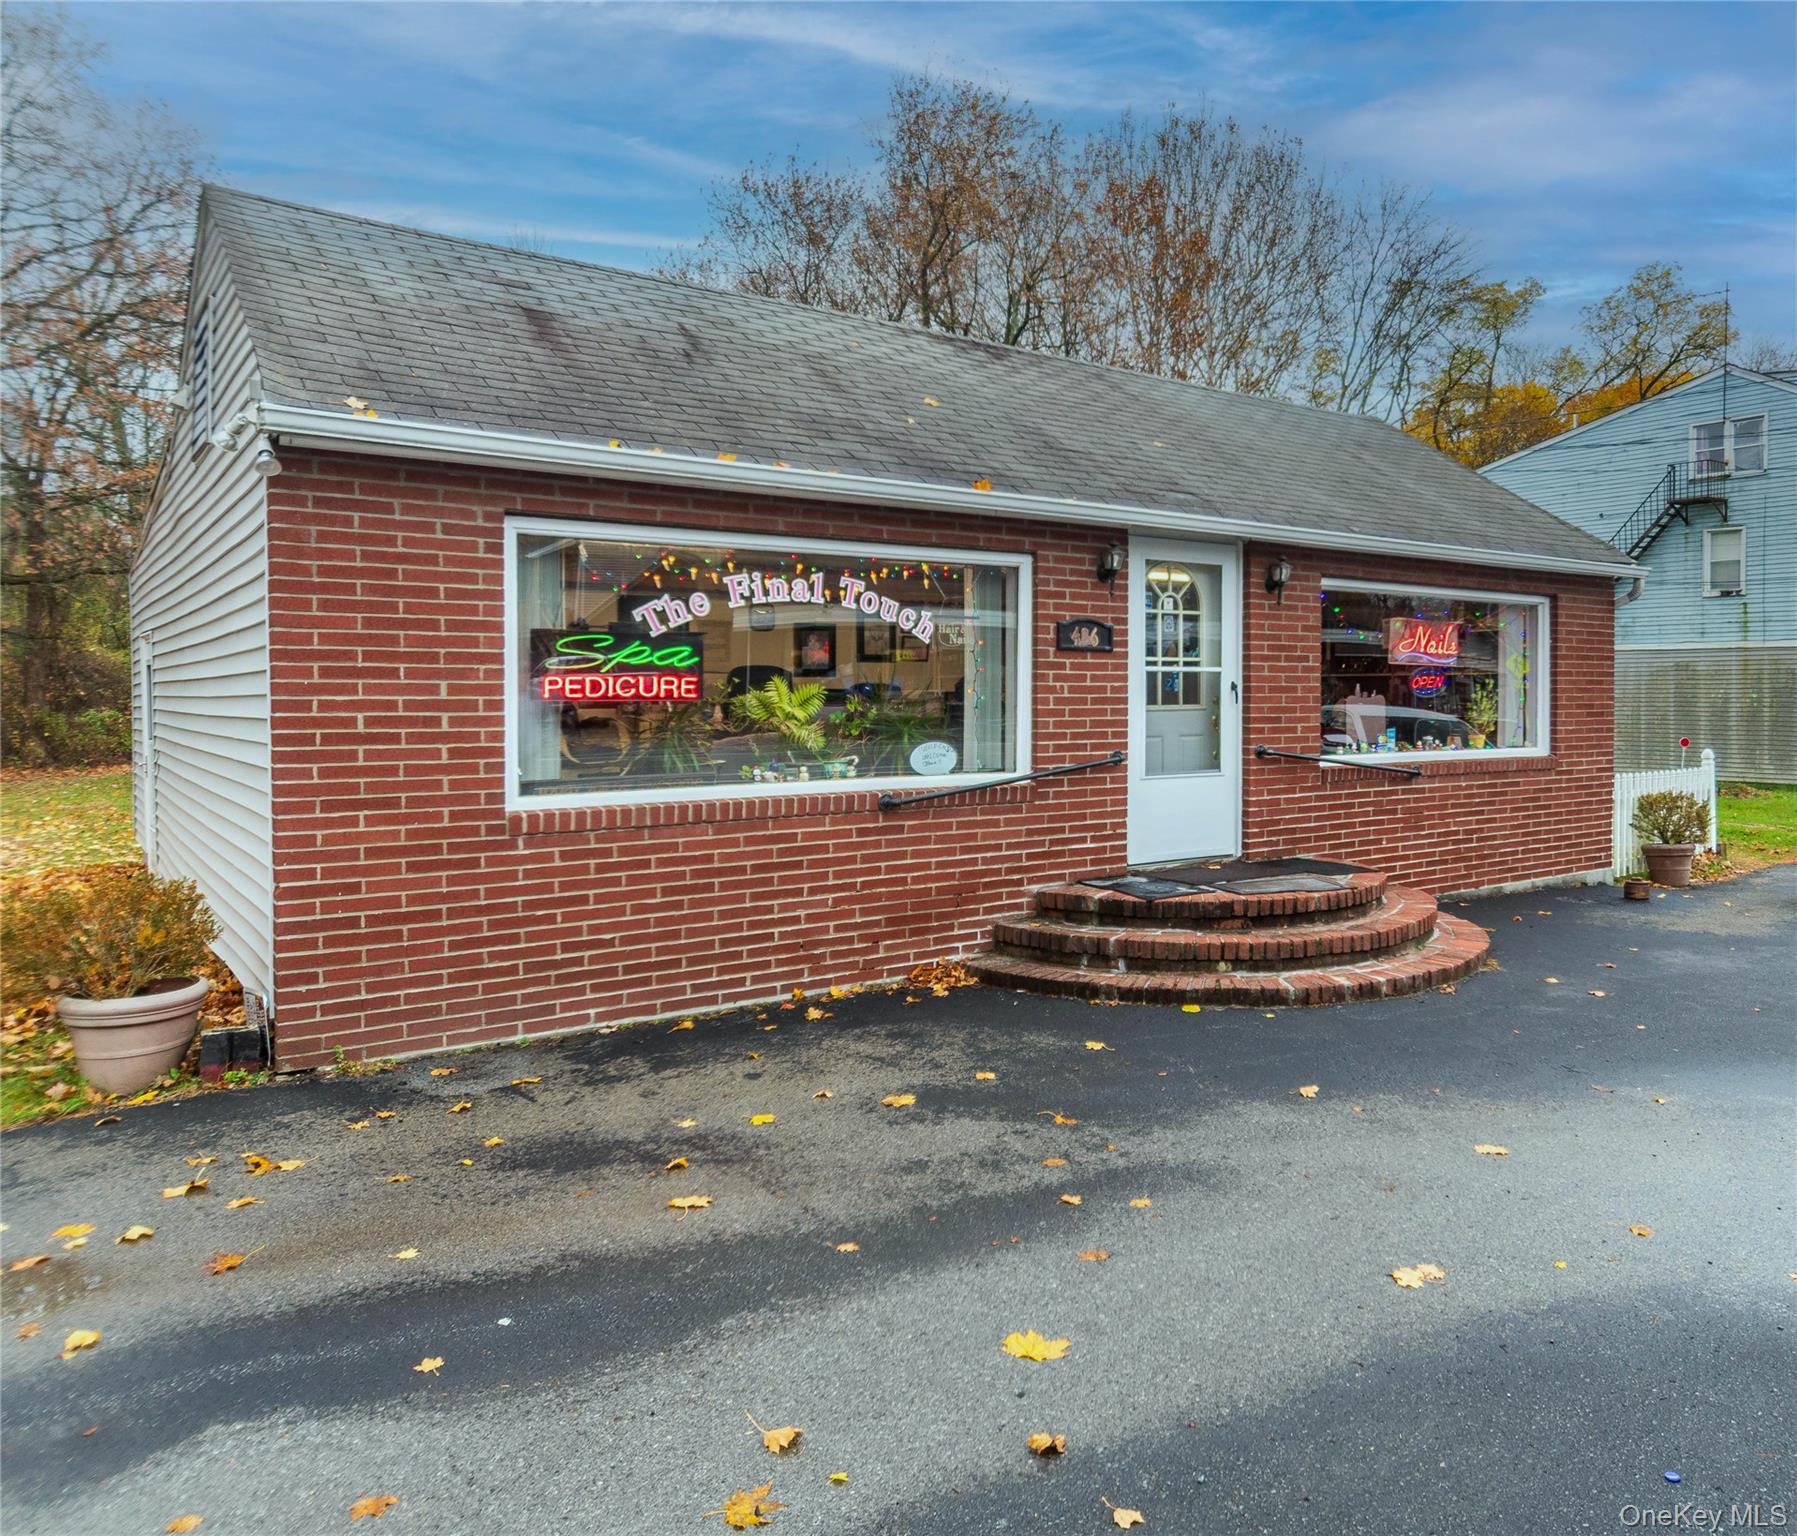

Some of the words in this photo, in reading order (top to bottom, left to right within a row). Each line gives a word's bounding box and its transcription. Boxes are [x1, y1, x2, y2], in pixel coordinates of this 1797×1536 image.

[631, 591, 711, 638] The
[722, 571, 825, 609] Final
[839, 575, 934, 645] Touch
[544, 634, 700, 674] Spa
[1398, 625, 1458, 655] Nails
[543, 675, 699, 699] PEDICURE
[1410, 675, 1446, 689] OPEN
